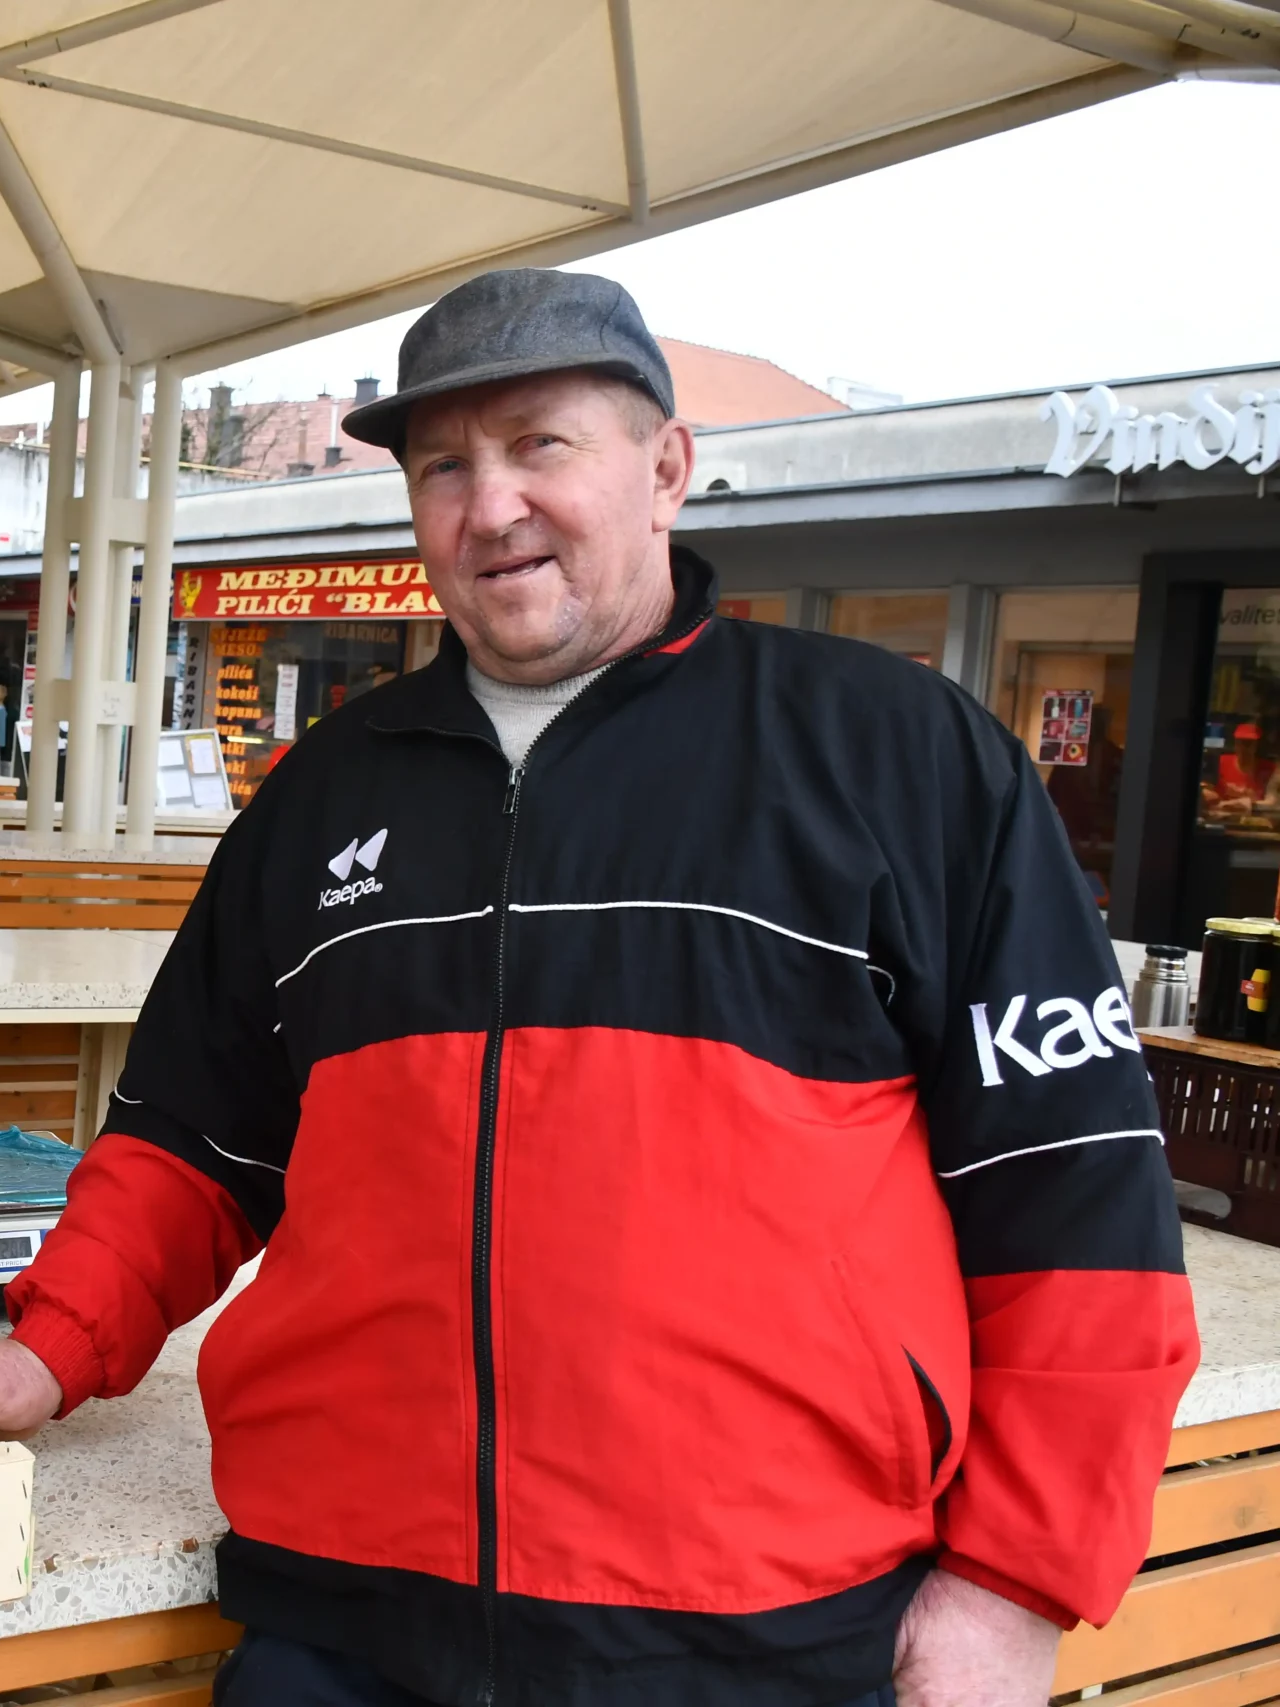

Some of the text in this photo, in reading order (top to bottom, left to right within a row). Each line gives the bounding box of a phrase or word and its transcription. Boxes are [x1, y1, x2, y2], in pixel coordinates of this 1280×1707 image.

[214, 586, 315, 616] PILIĆI
[317, 876, 377, 911] Kaepa
[969, 986, 1142, 1086] Kae
